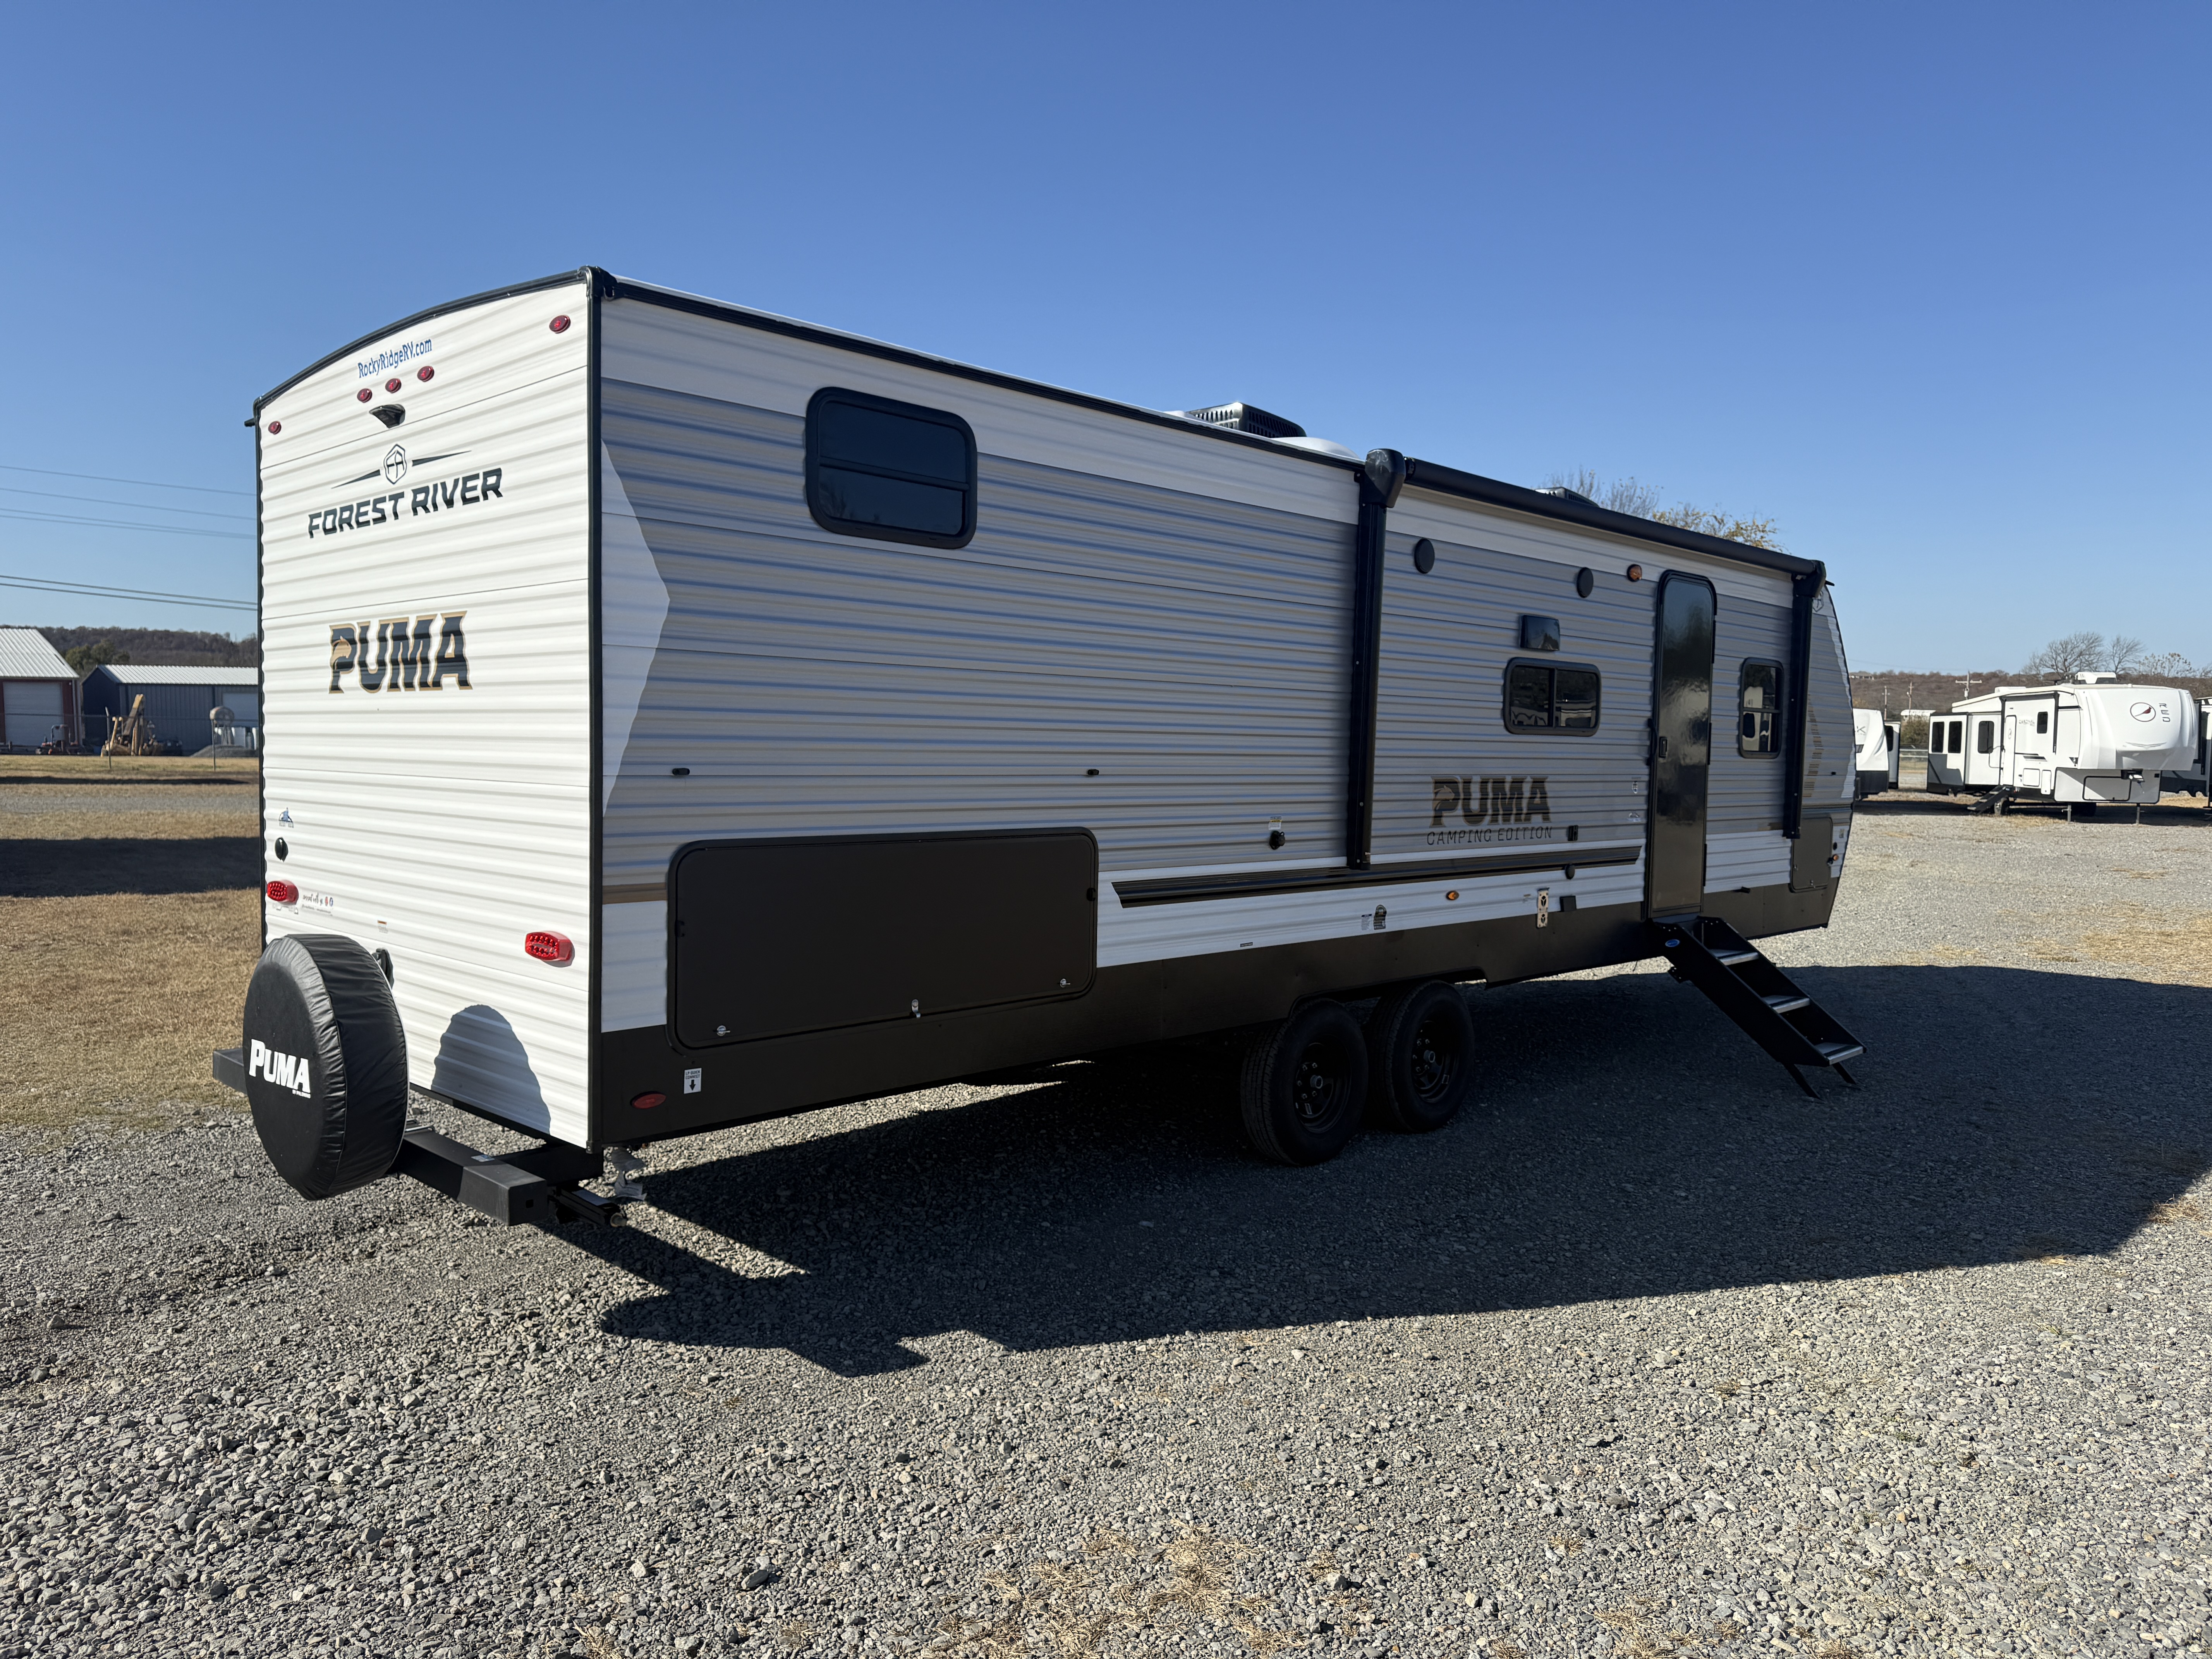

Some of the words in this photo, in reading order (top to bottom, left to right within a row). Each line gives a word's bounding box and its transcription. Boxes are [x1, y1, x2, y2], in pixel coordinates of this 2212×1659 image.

[358, 339, 432, 378] RockyRidgeRV.com
[308, 491, 404, 538] FOREST
[411, 467, 503, 516] RIVER
[329, 611, 473, 694] PUMA
[2159, 703, 2171, 722] RED
[1429, 776, 1552, 828] PUMA
[1427, 828, 1492, 846] CAMPING
[1498, 826, 1552, 841] EDITION
[249, 1039, 311, 1093] PUMA
